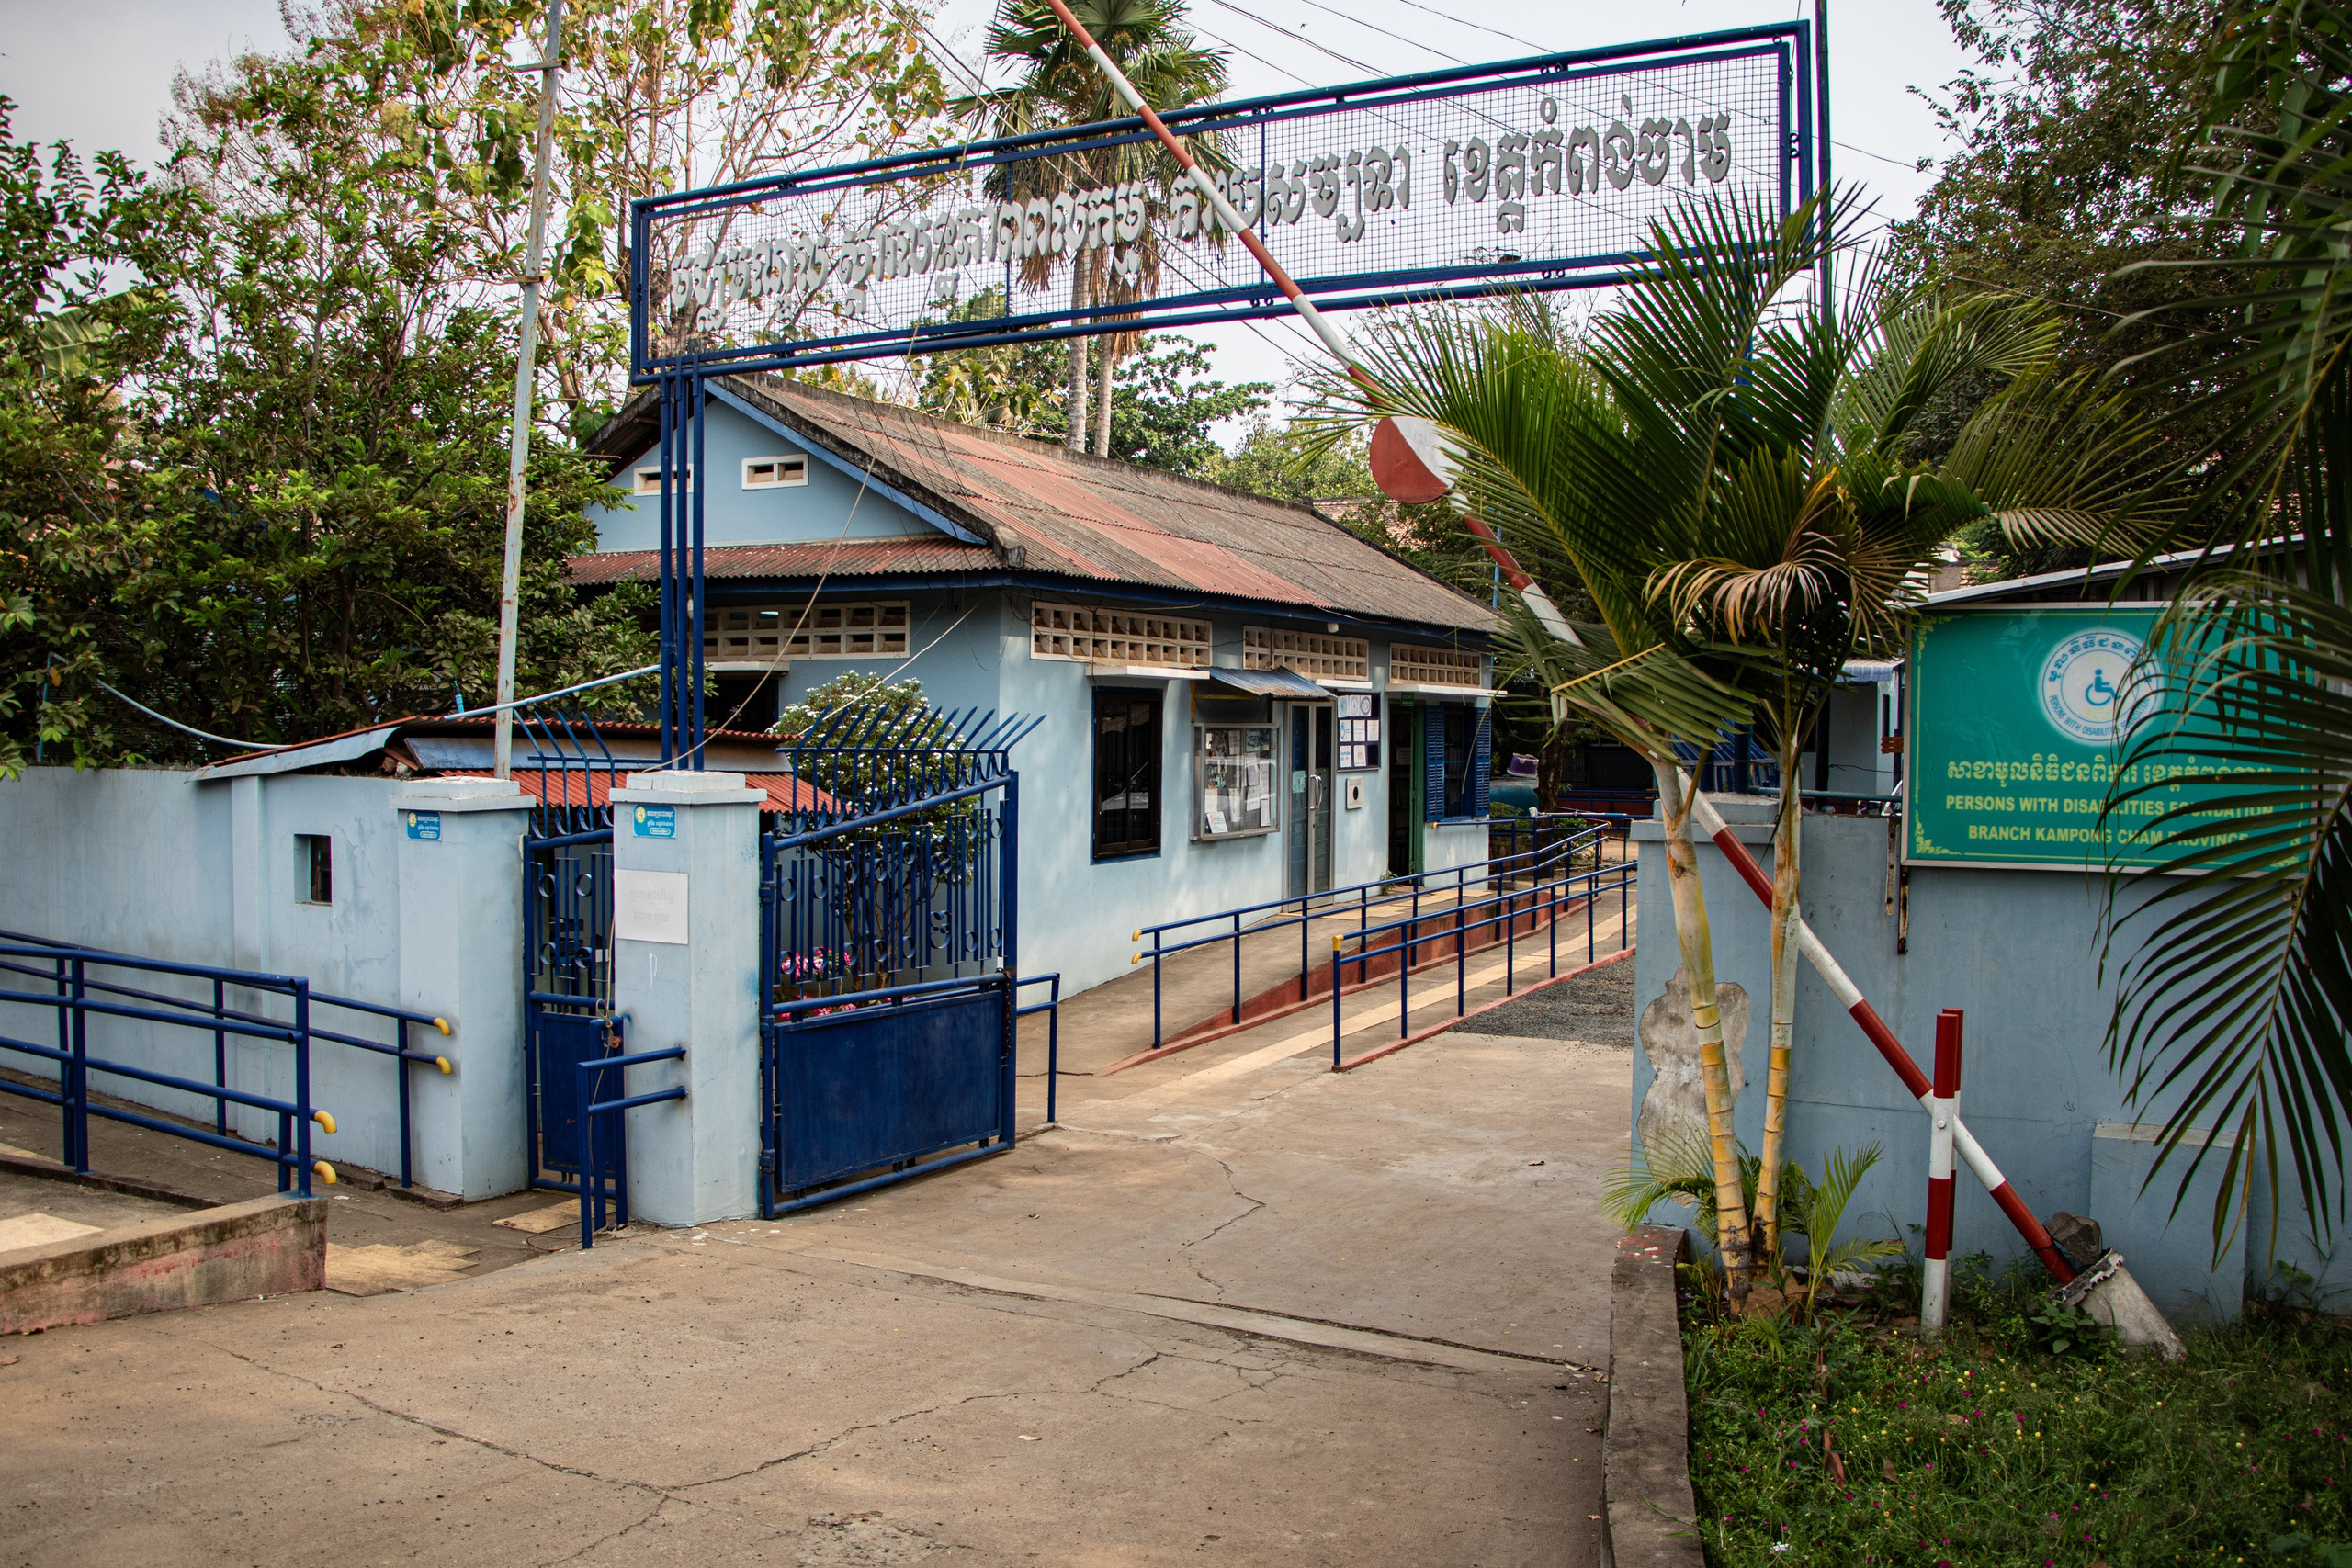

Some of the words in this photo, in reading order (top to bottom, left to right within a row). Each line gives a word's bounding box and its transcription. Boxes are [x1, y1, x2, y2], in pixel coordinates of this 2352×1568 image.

[2049, 694, 2066, 719] PERSONS
[2064, 716, 2081, 731] WITH
[1946, 795, 2015, 811] PERSONS
[2019, 797, 2058, 812] WITH
[1969, 825, 2030, 840] BRANCH
[2036, 827, 2112, 843] KAMPONG
[2117, 829, 2163, 844] CHAM
